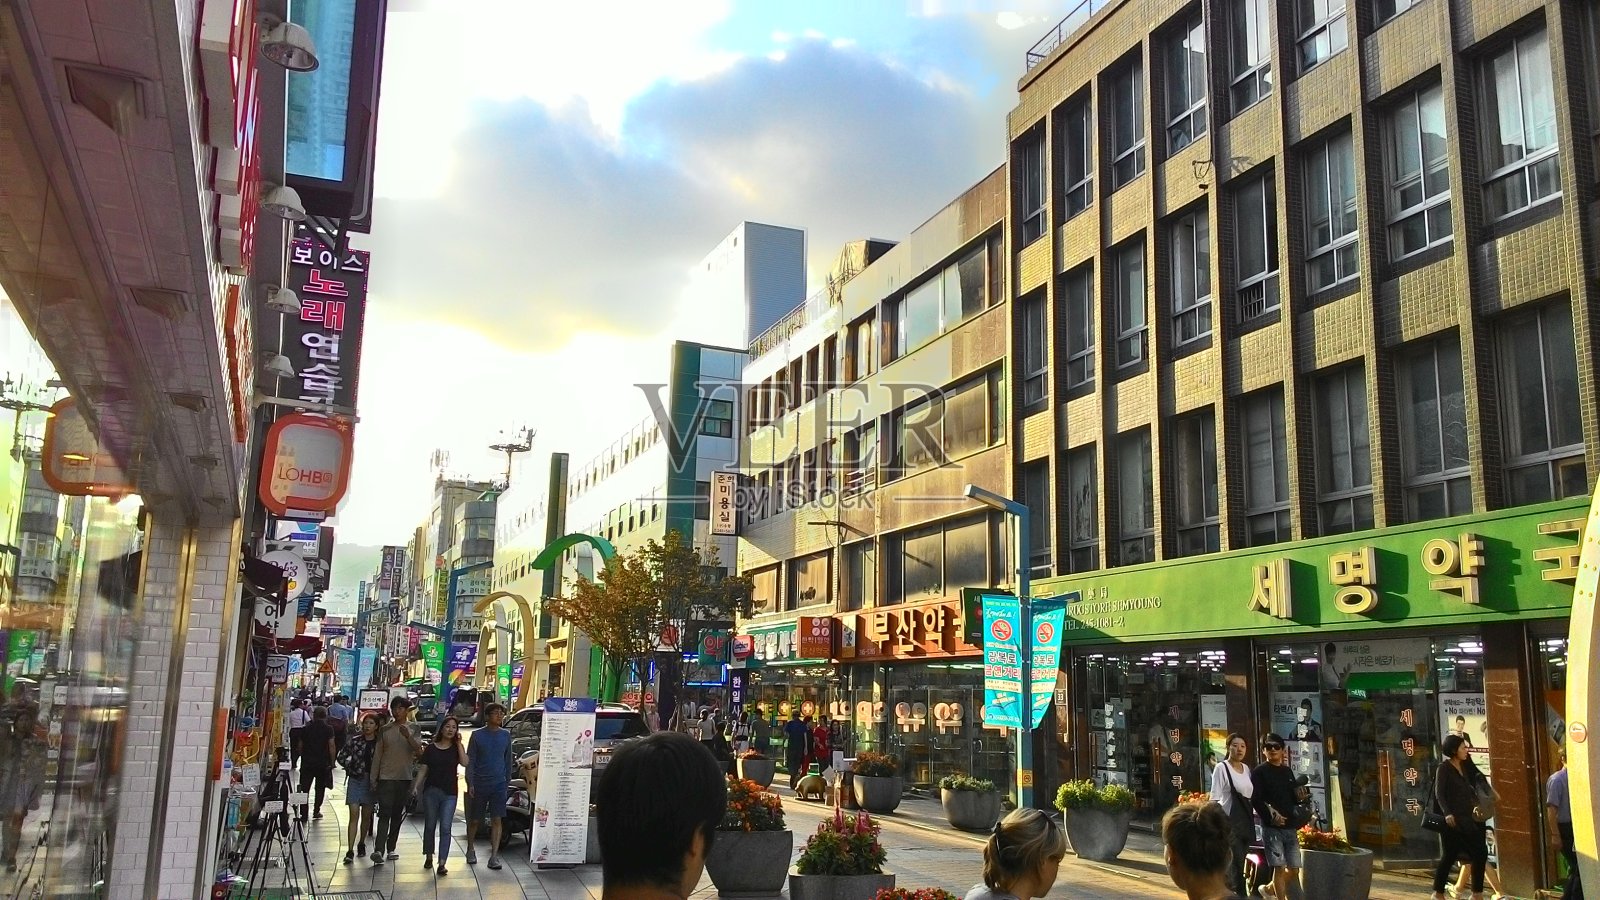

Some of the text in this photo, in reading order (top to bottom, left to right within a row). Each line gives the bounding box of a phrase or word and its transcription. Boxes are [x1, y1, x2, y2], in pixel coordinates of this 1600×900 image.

[292, 247, 364, 272] 보이스
[719, 485, 731, 523] 미용실
[704, 635, 724, 661] 약
[988, 651, 1017, 664] 광복로
[985, 664, 1022, 680] 금연거리
[1057, 693, 1064, 701] 33
[1168, 705, 1183, 789] 세명약국
[1400, 708, 1420, 816] 세명약국
